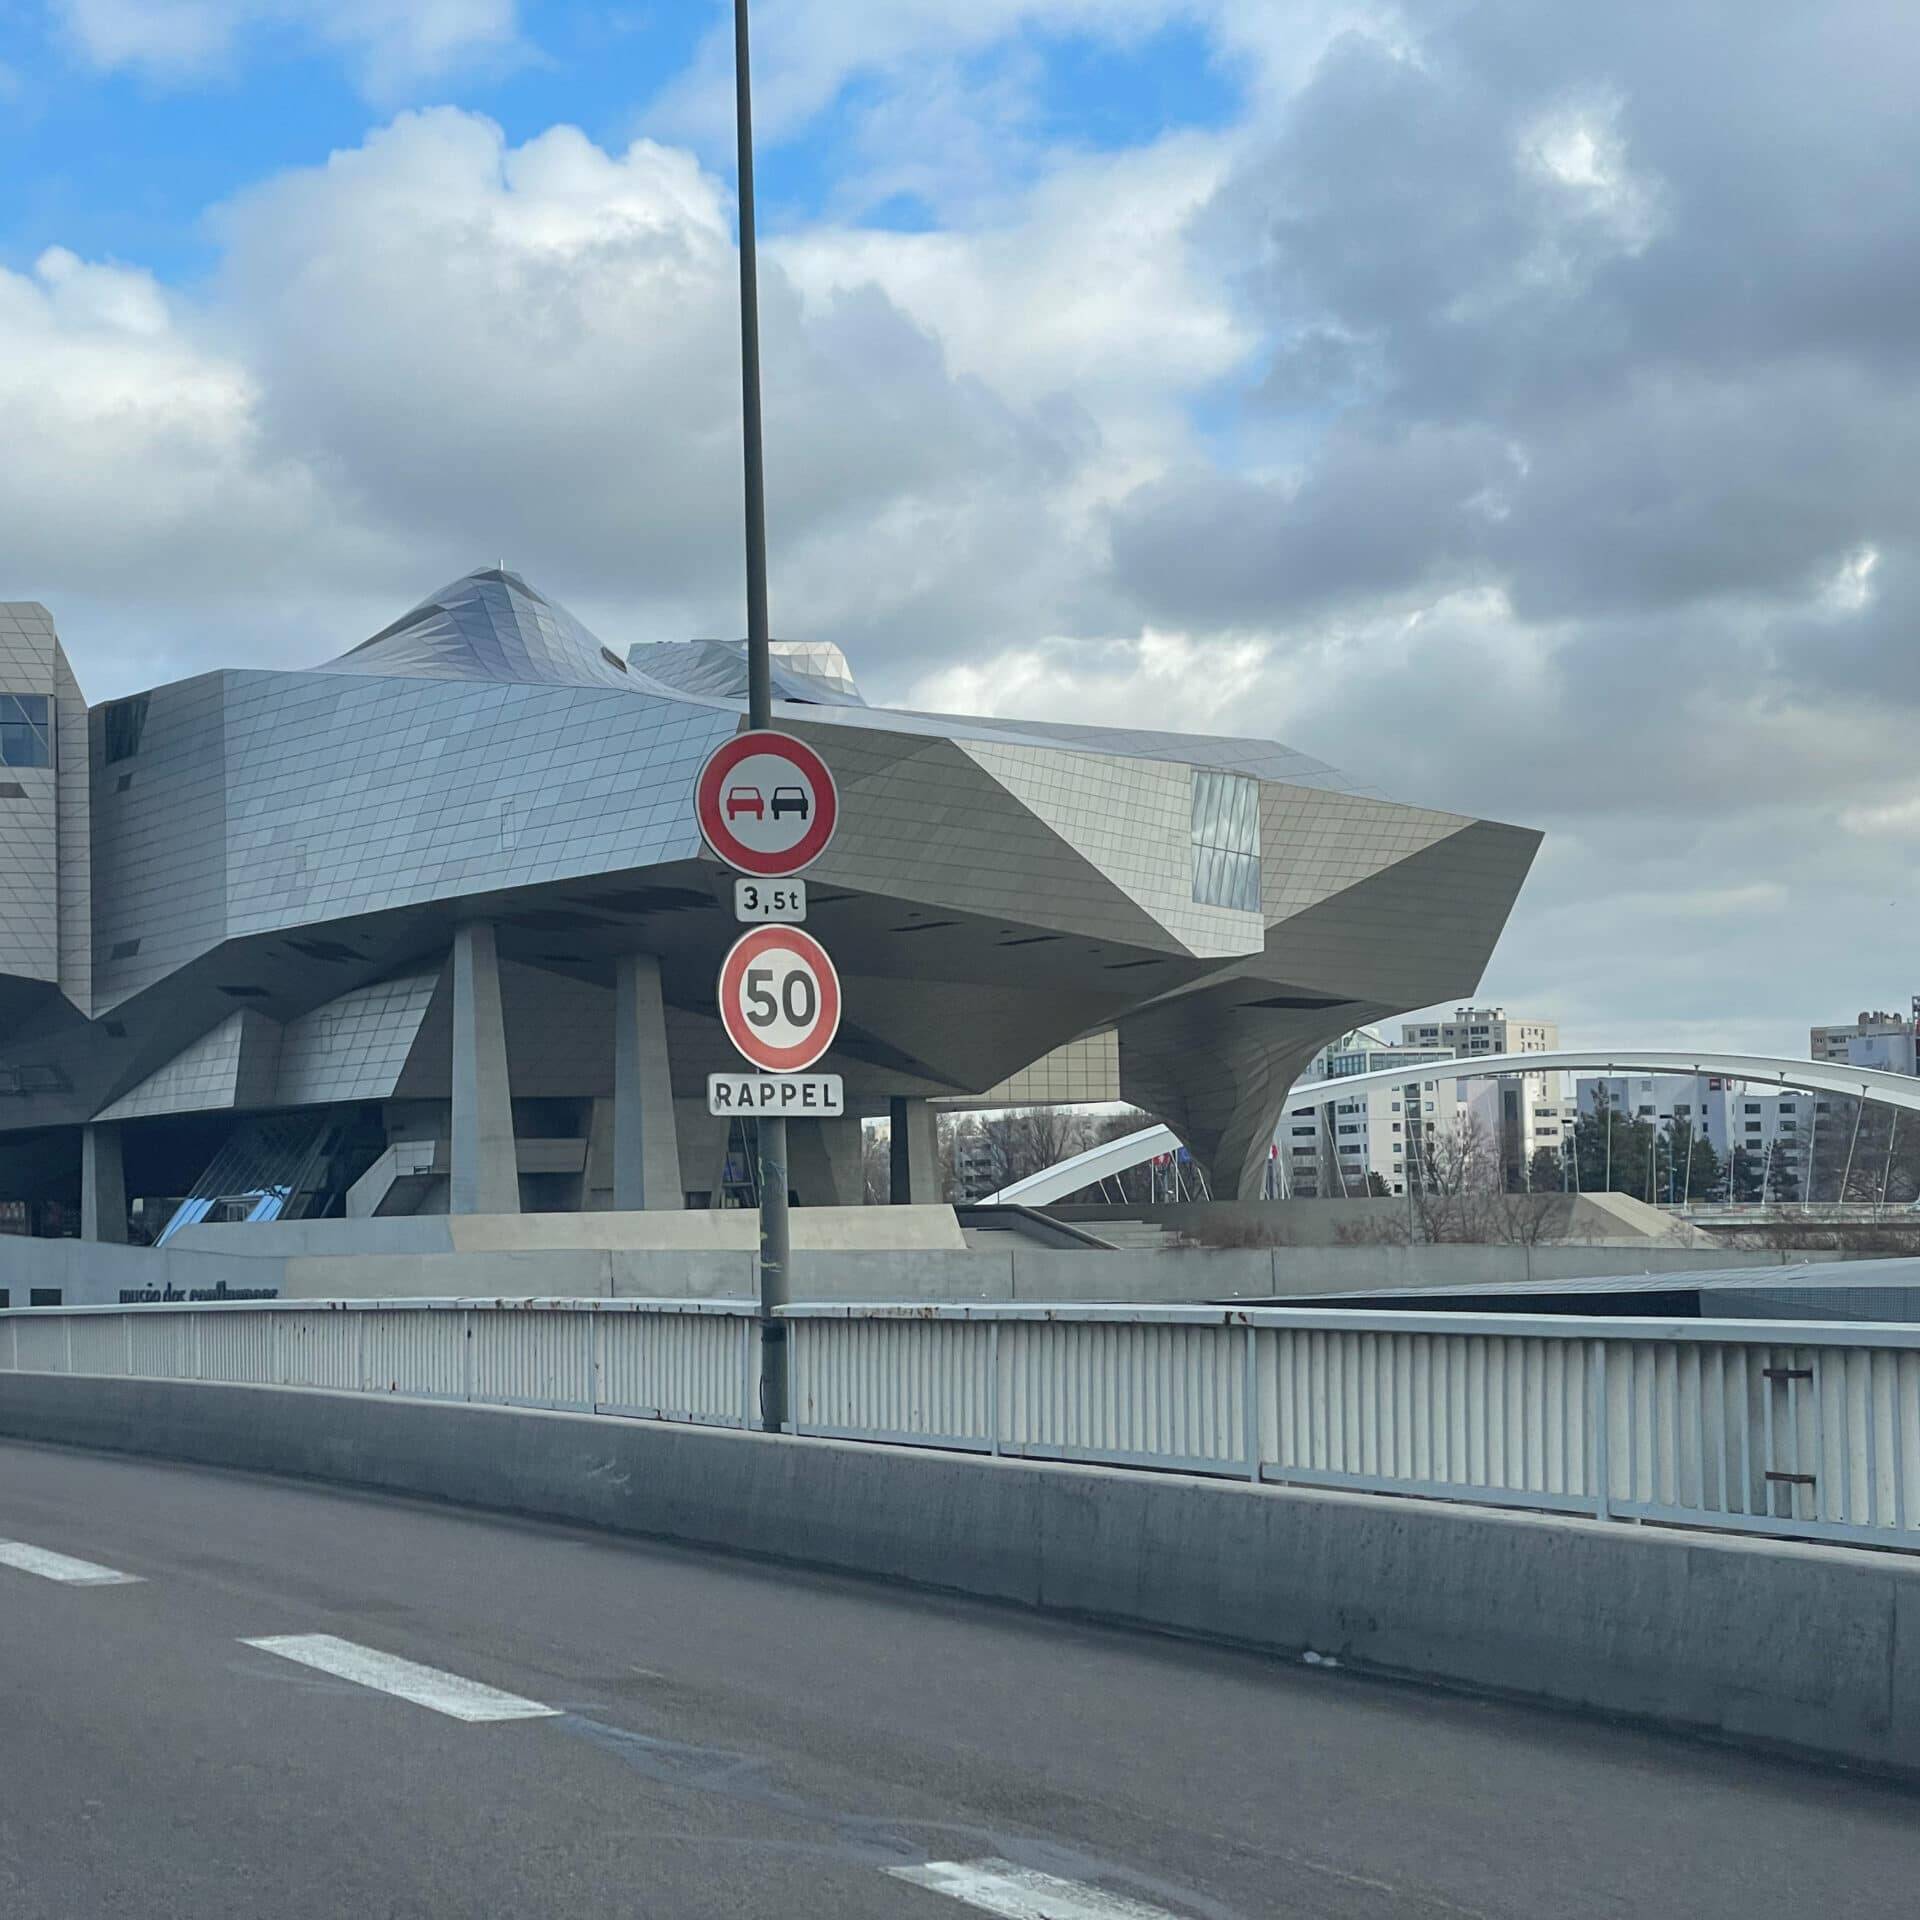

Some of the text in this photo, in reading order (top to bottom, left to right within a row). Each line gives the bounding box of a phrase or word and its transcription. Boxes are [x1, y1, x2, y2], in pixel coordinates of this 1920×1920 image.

[743, 886, 799, 914] 3,5t
[746, 969, 816, 1027] 50
[715, 1083, 837, 1107] RAPPEL
